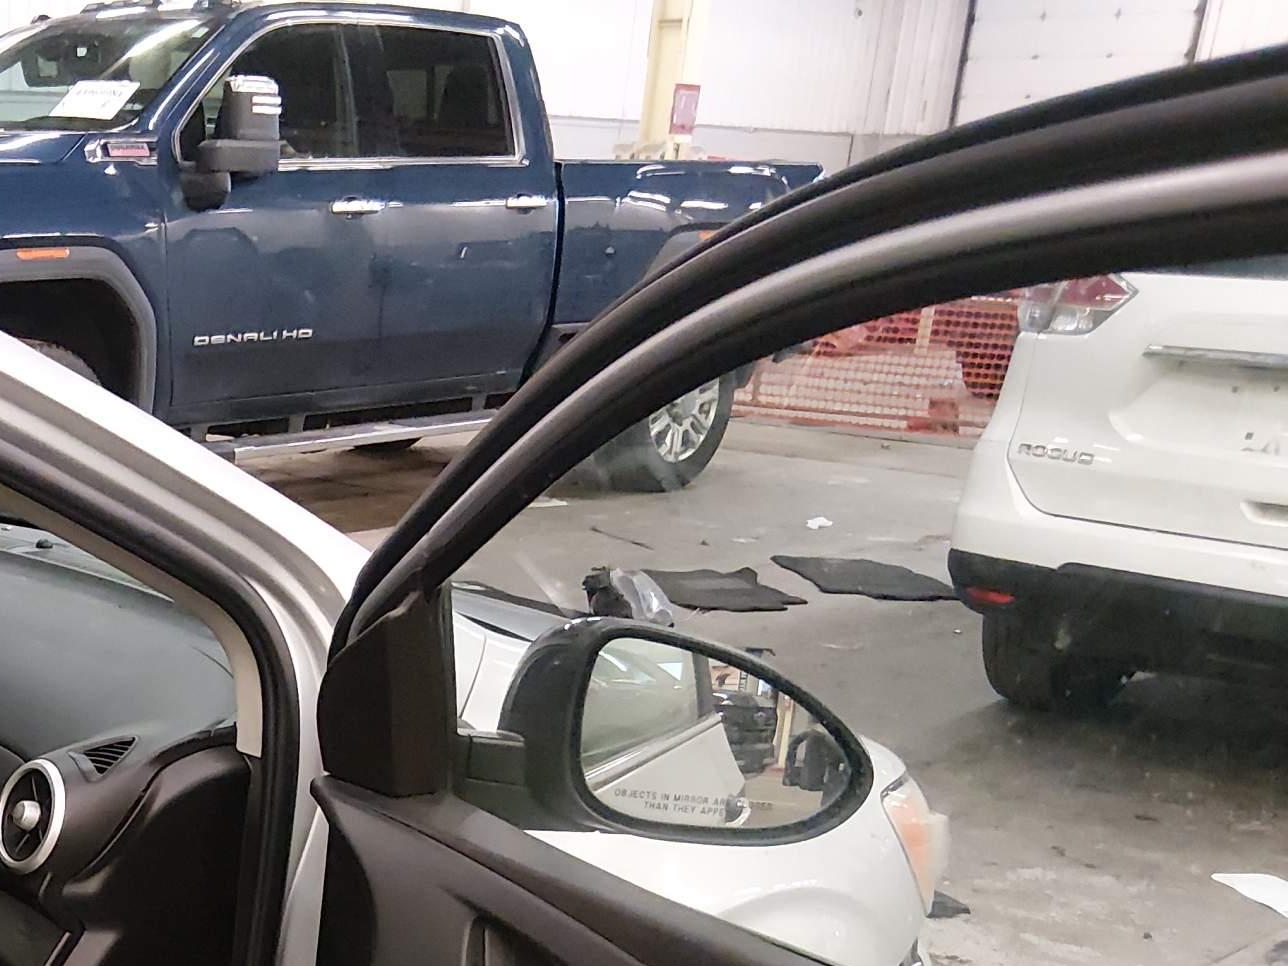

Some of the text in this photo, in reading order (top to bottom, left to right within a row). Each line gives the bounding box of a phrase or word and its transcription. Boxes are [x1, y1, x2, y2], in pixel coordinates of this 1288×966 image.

[193, 327, 313, 347] DENALI HD
[1017, 443, 1094, 465] ROGUE
[614, 788, 657, 800] OBJECTS
[661, 793, 670, 801] IN
[673, 793, 709, 805] MIRROR
[643, 800, 669, 810] THAN
[673, 804, 696, 814] THEY
